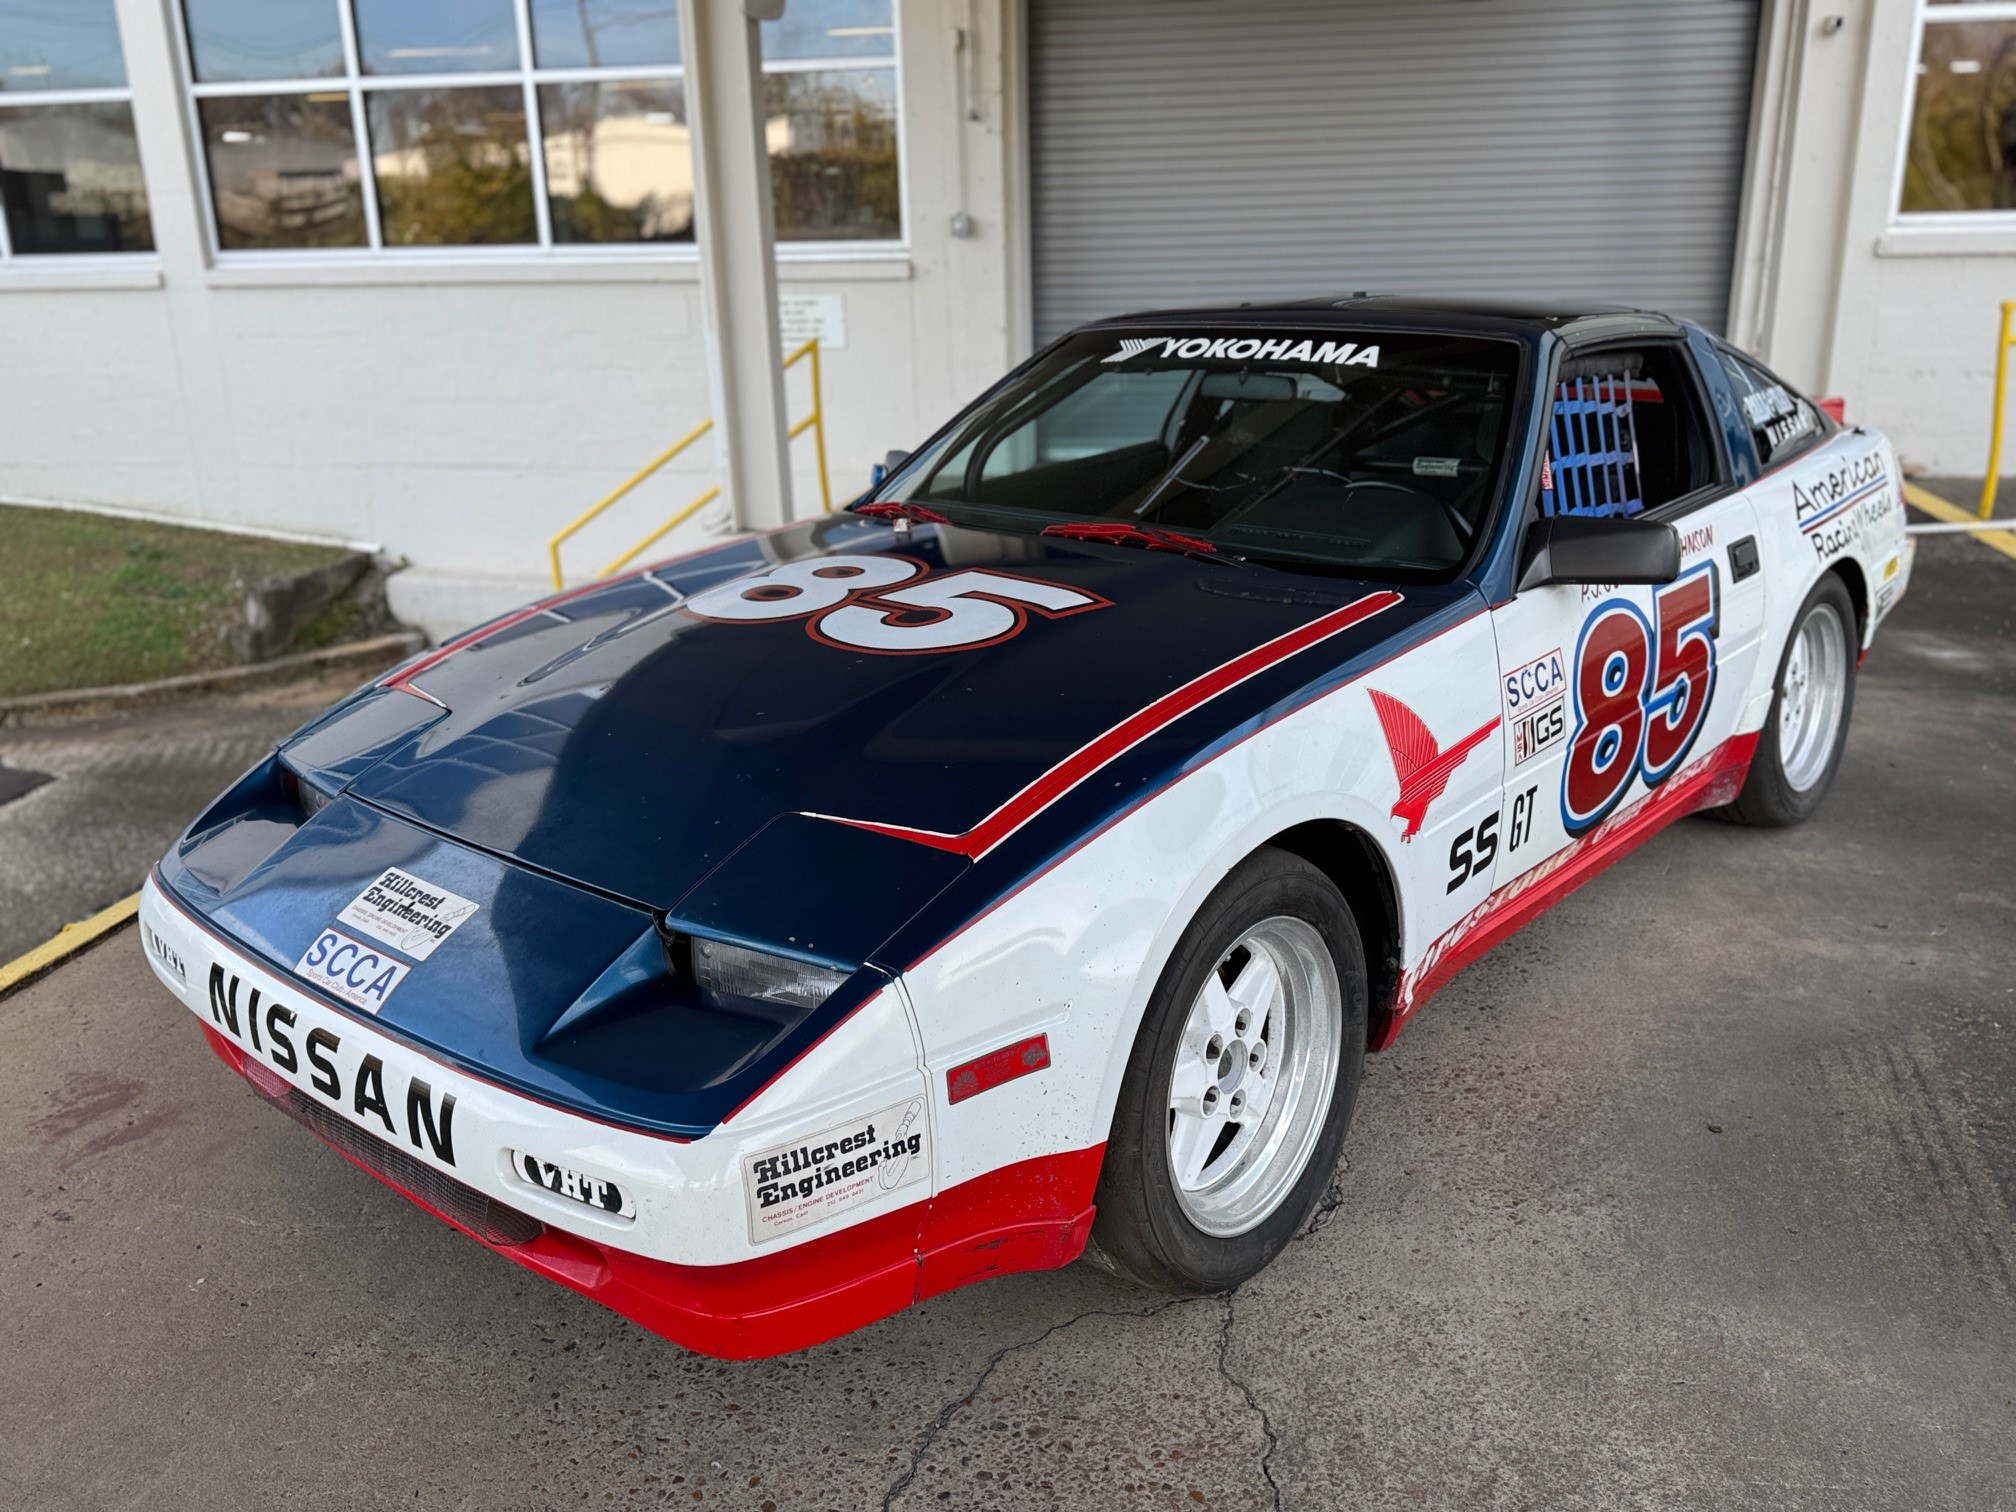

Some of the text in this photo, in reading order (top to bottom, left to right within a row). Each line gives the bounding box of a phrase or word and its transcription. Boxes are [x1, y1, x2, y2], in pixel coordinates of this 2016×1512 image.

[1160, 338, 1380, 368] YOKOHAMA
[1791, 452, 1886, 520] American
[678, 553, 1117, 655] 85
[1507, 656, 1563, 707] SCCA
[1561, 559, 1718, 836] 85
[1536, 705, 1563, 745] GS
[1446, 810, 1500, 896] SS
[1509, 784, 1538, 853] GT
[362, 886, 453, 939] Engineering
[379, 872, 446, 910] Hillcrest
[306, 933, 398, 1002] SCCA
[208, 961, 458, 1168] NISSAN
[532, 1155, 609, 1209] VHT
[753, 1124, 876, 1184] Hillcrest
[756, 1133, 922, 1209] Engineering
[825, 1175, 874, 1200] DEVELOPMENT
